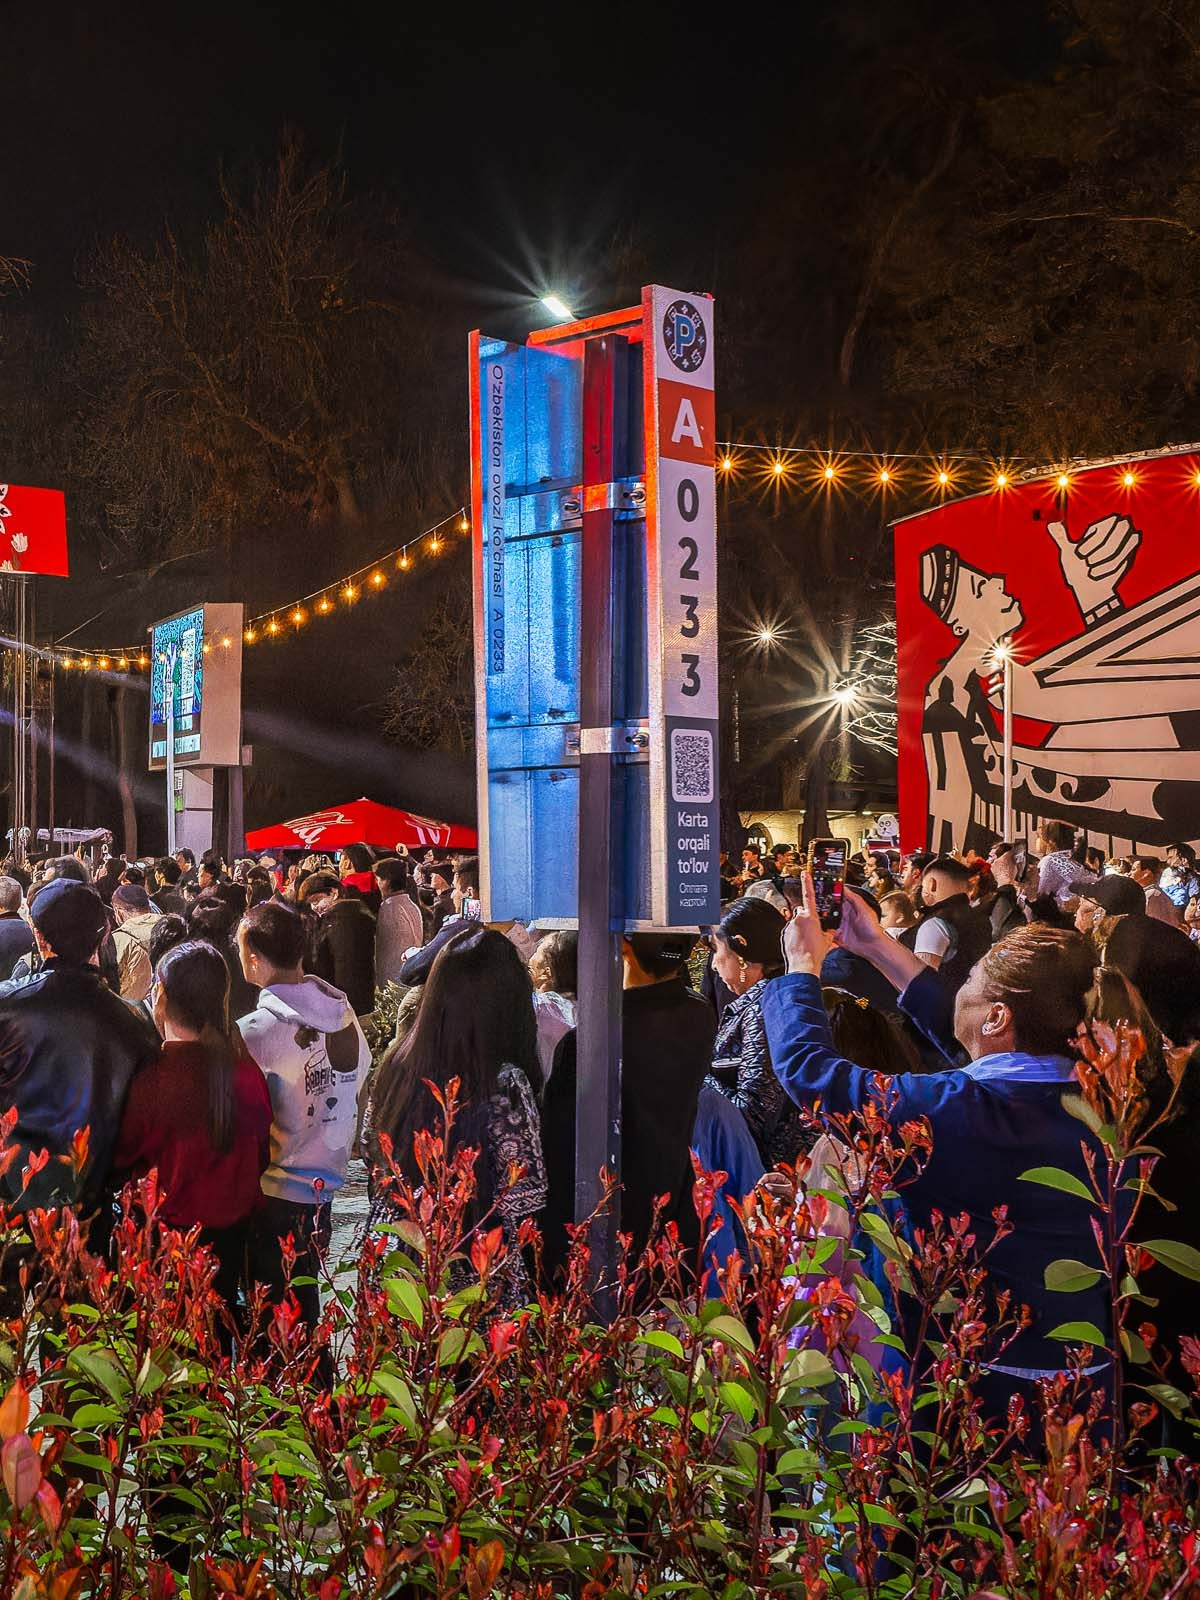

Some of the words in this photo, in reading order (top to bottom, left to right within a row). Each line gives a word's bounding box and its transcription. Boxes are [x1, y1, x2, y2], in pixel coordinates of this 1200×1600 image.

[671, 398, 704, 448] A
[493, 608, 504, 622] A
[493, 628, 505, 672] 0233
[677, 811, 709, 828] Karta
[677, 834, 710, 854] orqali
[677, 857, 709, 874] to'lov
